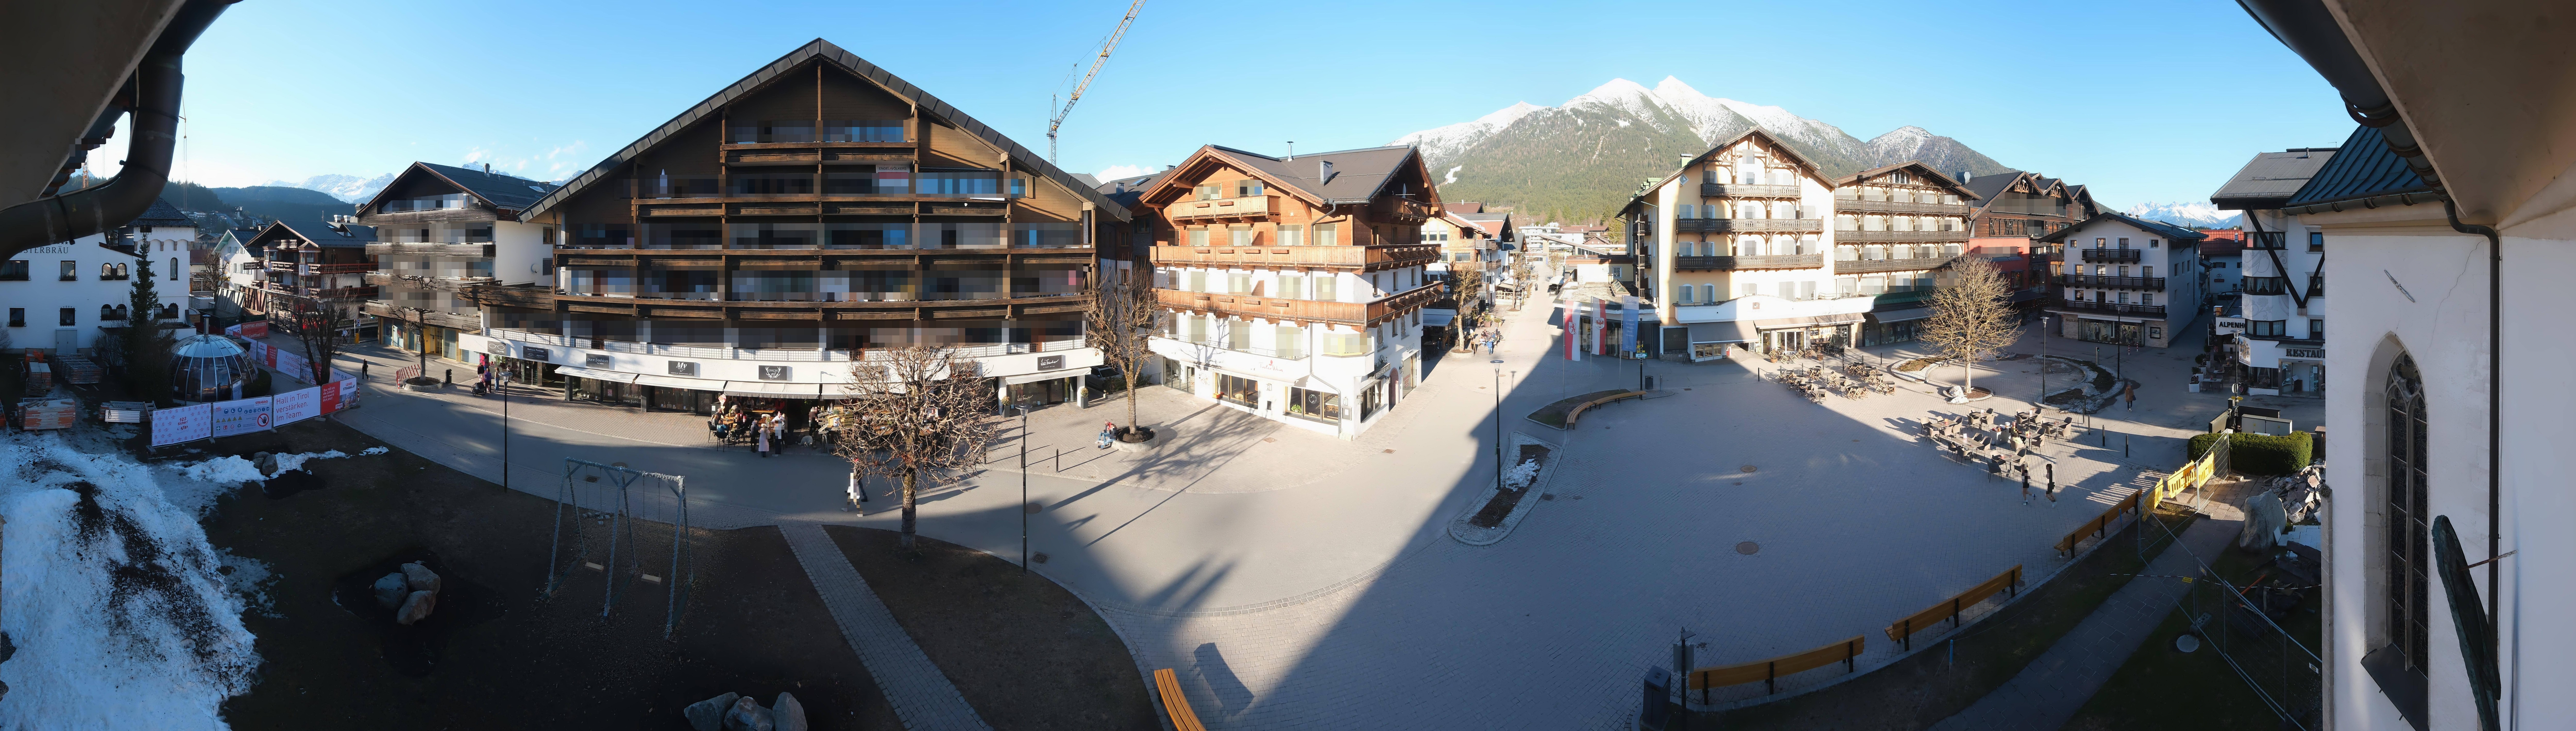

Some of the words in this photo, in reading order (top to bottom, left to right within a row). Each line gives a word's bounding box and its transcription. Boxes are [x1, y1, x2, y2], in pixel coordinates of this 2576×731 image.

[1376, 365, 1389, 378] RESTAURANT
[277, 396, 288, 405] Hall
[297, 392, 309, 400] Tirol
[276, 402, 308, 413] verstärken.
